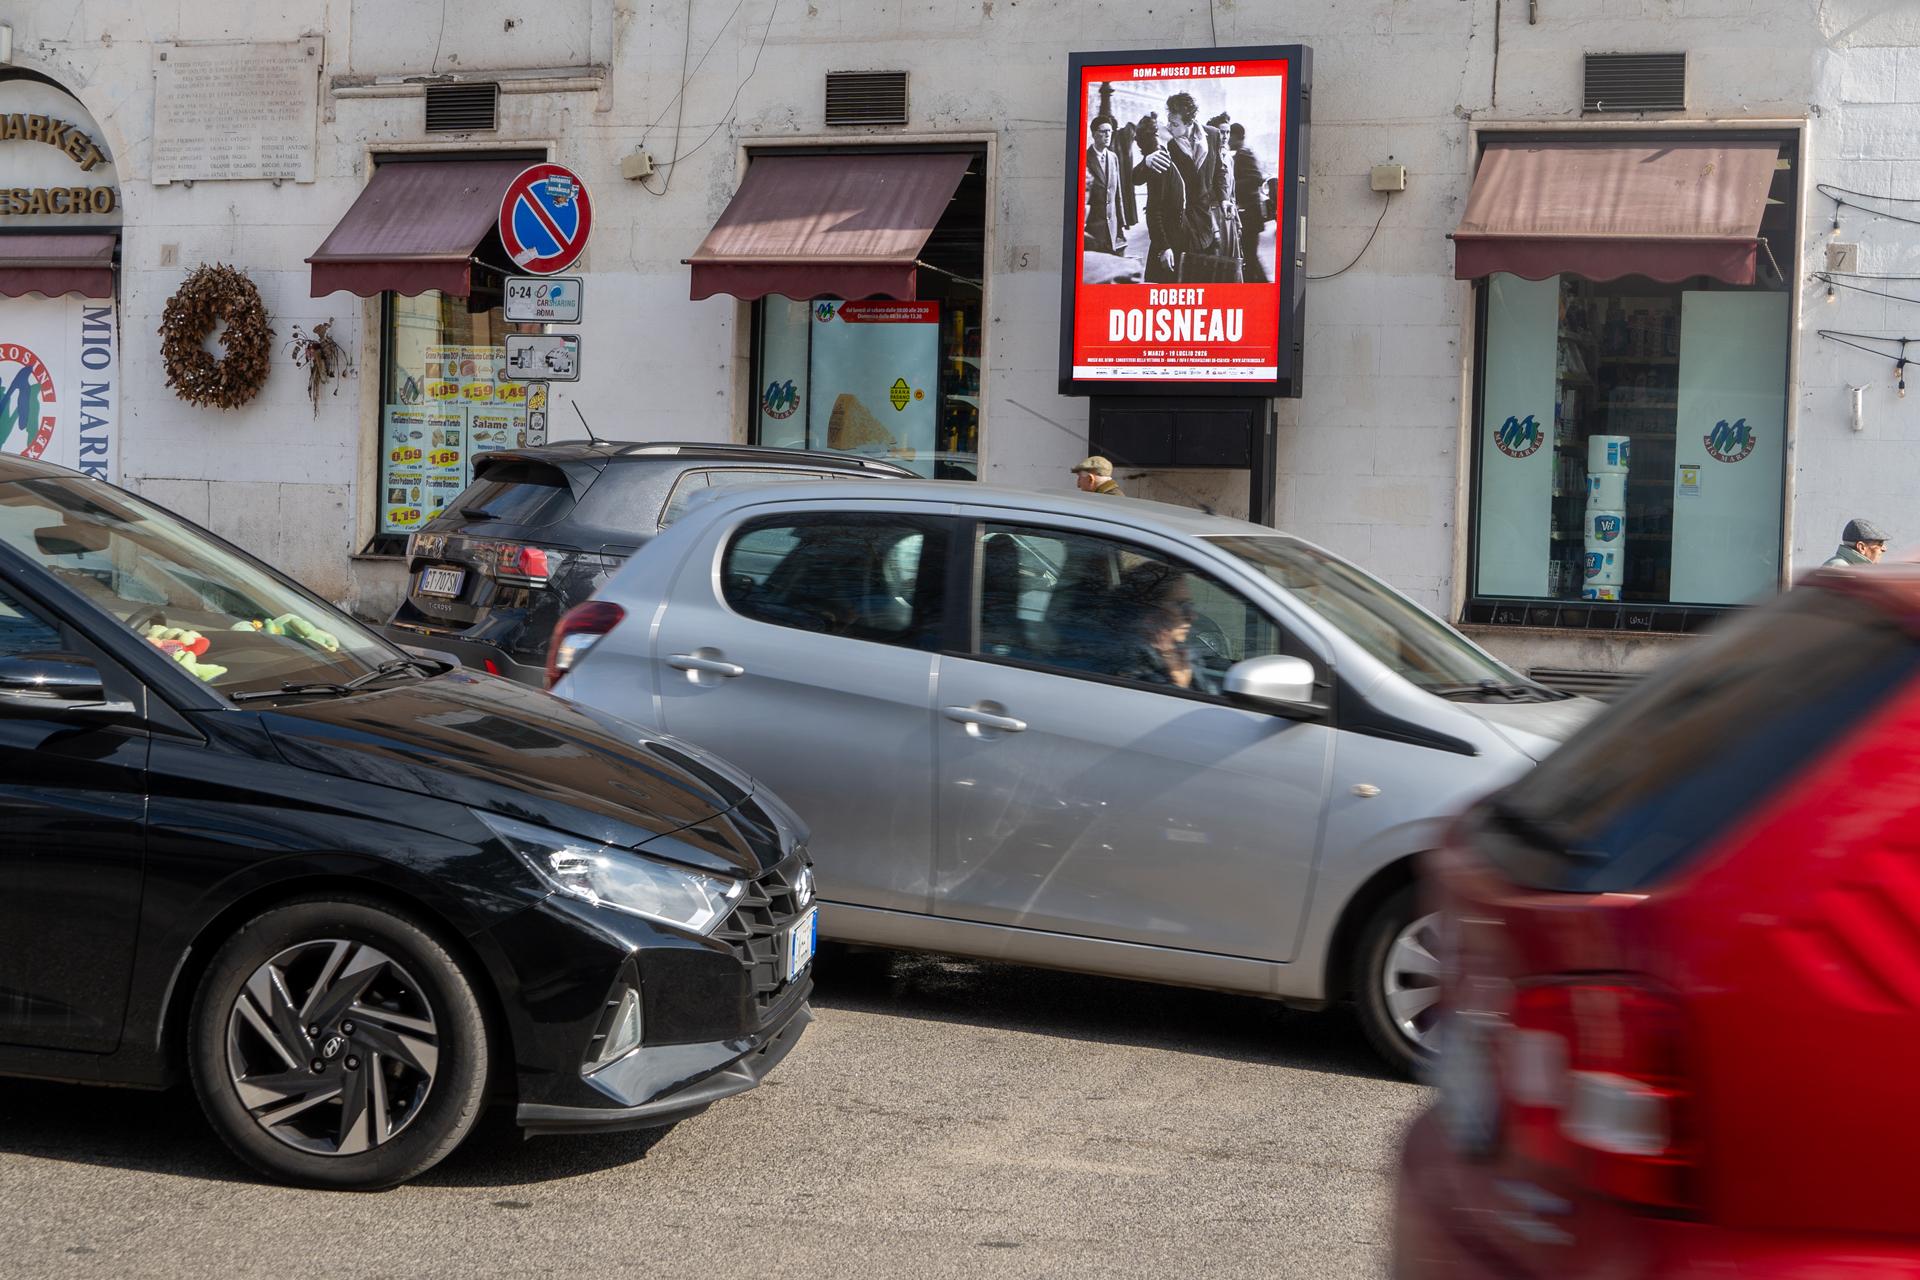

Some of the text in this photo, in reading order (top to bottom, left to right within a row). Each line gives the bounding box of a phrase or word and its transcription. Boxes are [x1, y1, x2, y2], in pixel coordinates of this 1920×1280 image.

[1192, 66, 1207, 75] DEL
[1209, 65, 1236, 75] GENIO
[0, 113, 108, 171] ARKET
[1020, 253, 1030, 268] 5
[1836, 251, 1847, 267] 7
[509, 286, 531, 299] 0-24
[1149, 288, 1205, 306] ROBERT
[536, 309, 555, 317] ROMA
[1109, 308, 1244, 342] DOISNEAU
[81, 304, 113, 371] MIO
[472, 419, 508, 429] Salame
[1510, 434, 1544, 457] MARKET
[1722, 438, 1756, 462] MARKET
